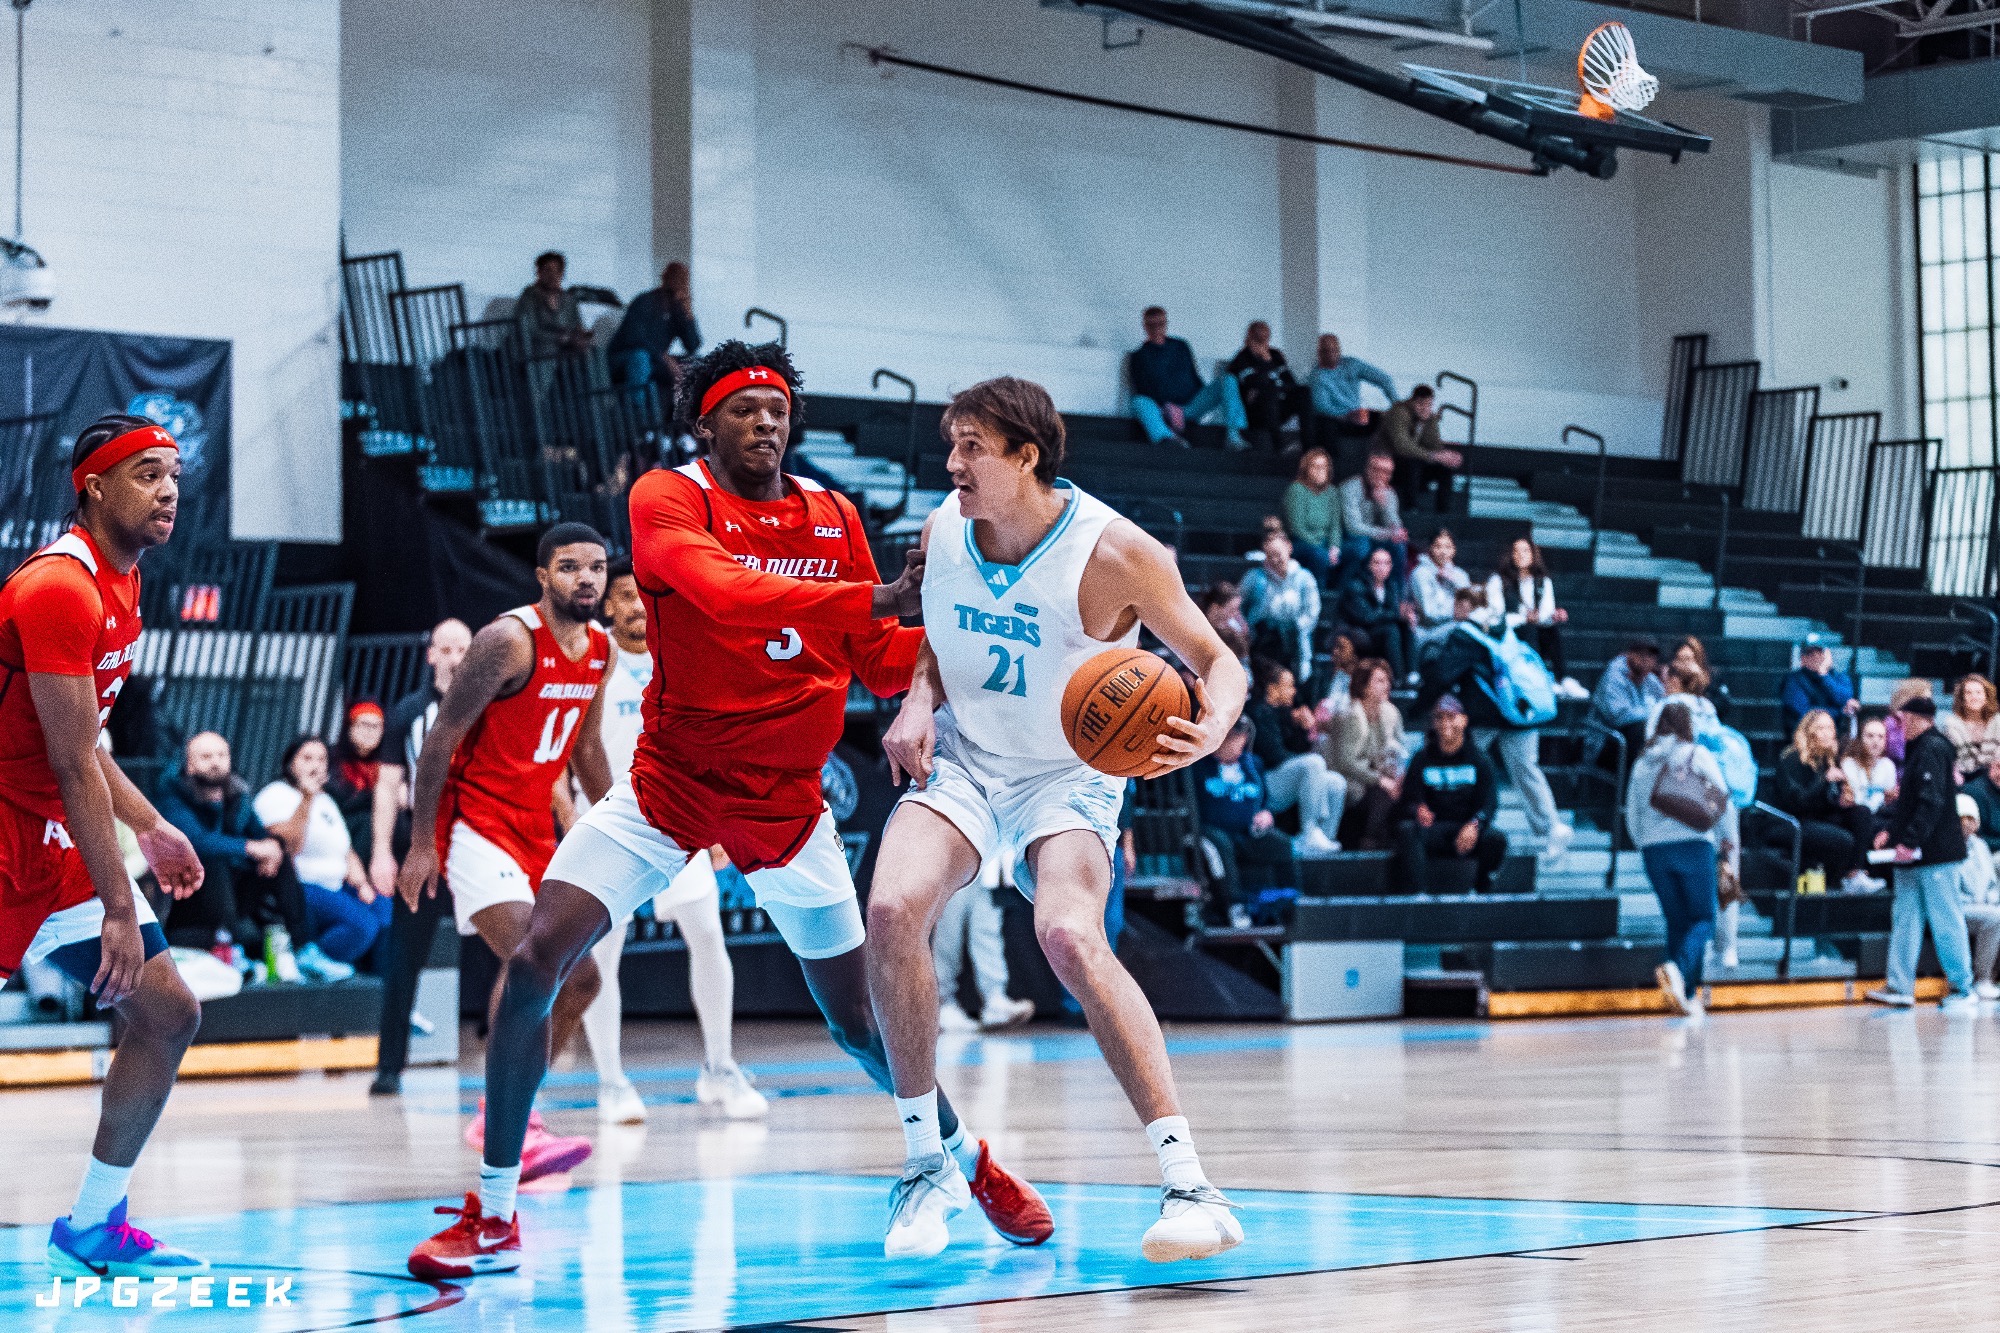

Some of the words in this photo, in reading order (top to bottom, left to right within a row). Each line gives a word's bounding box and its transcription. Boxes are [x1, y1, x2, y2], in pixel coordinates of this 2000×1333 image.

[953, 603, 1042, 648] TIGERS
[980, 644, 1027, 698] 21
[1080, 701, 1112, 743] THE
[1099, 666, 1148, 709] ROCK
